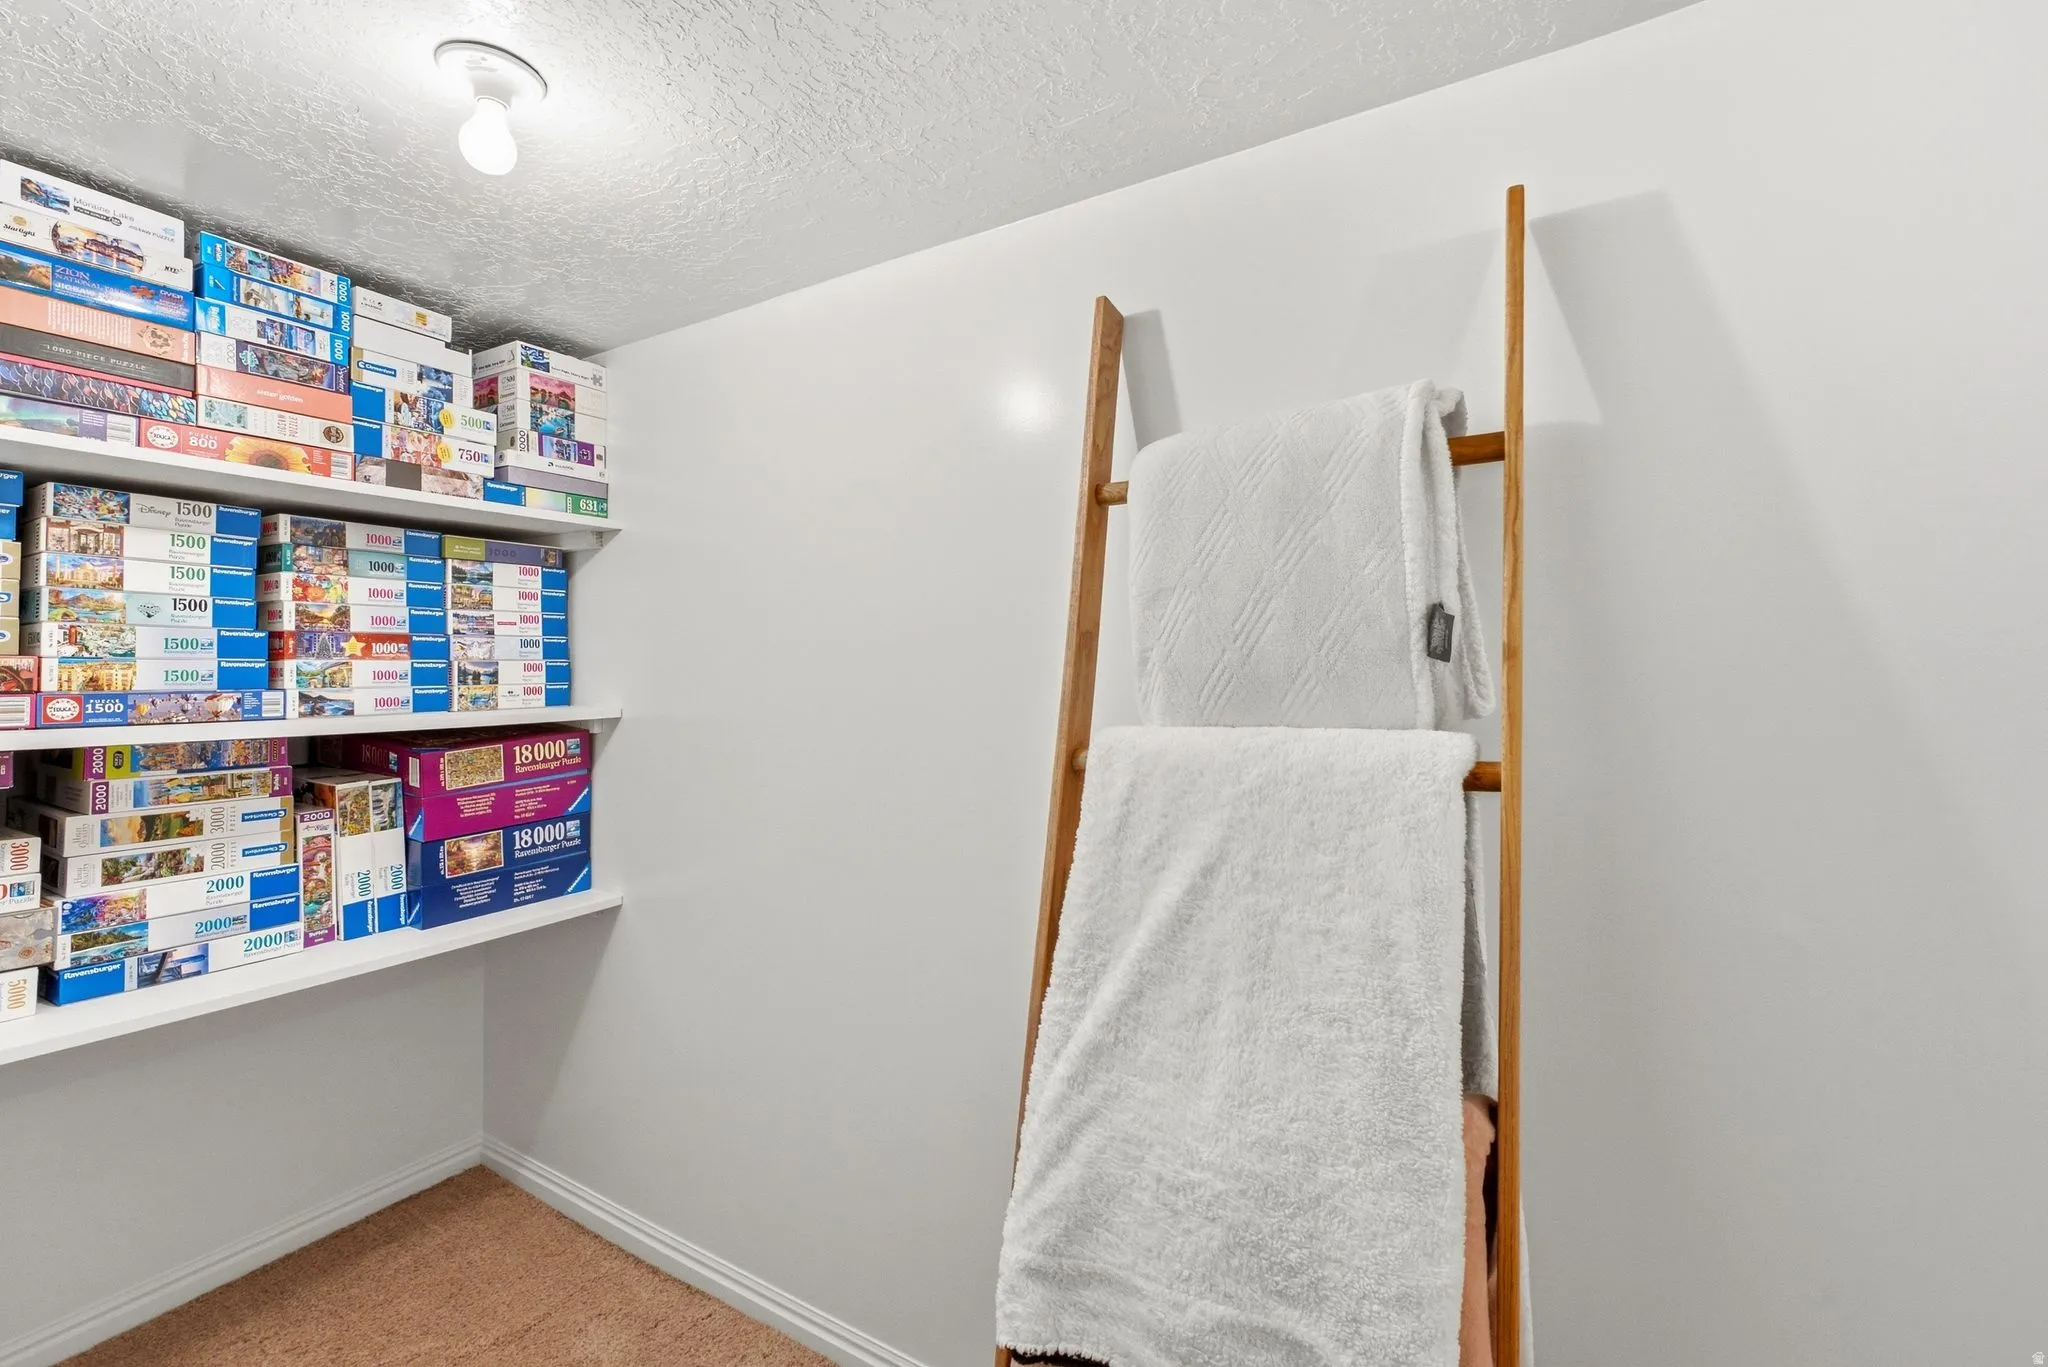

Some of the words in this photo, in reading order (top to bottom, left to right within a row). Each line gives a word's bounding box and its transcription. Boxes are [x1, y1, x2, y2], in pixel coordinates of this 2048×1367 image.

[55, 264, 90, 281] ZION
[338, 280, 348, 302] 1000
[341, 311, 351, 332] 1000
[334, 338, 343, 361] 1000
[76, 349, 107, 363] PIECE
[109, 358, 147, 371] PUZZLE
[279, 391, 304, 404] golden
[461, 414, 482, 429] 500
[189, 436, 218, 450] 800
[458, 448, 481, 463] 750
[136, 502, 172, 518] Disney
[176, 501, 212, 518] 1500
[580, 498, 598, 511] 631
[170, 533, 206, 550] 1500
[366, 533, 392, 546] 1000
[170, 566, 206, 581] 1500
[369, 561, 395, 573] 1000
[518, 566, 539, 577] 1000
[368, 588, 394, 599] 1000
[518, 590, 539, 601] 1000
[172, 598, 208, 613] 1500
[370, 615, 396, 627] 1000
[519, 614, 540, 625] 1000
[164, 637, 199, 650] 1500
[371, 642, 398, 654] 1000
[520, 638, 540, 648] 1000
[523, 663, 543, 672] 1000
[164, 669, 199, 682] 1500
[372, 670, 398, 681] 1000
[523, 686, 543, 696] 1000
[85, 703, 124, 714] 1500
[374, 697, 400, 708] 1000
[513, 740, 565, 764] 18000
[92, 747, 104, 774] 2000
[515, 760, 561, 774] Ravensburger
[562, 756, 582, 766] Puzzle
[95, 784, 107, 811] 2000
[210, 806, 225, 834] 3000
[303, 811, 331, 822] 2000
[513, 822, 565, 849] 18000
[10, 841, 30, 871] 3000
[514, 842, 560, 859] Ravensburger
[561, 838, 581, 849] Puzzle
[211, 842, 226, 871] 2000
[253, 866, 297, 879] Ravensburger
[390, 863, 404, 890] 2000
[206, 875, 244, 894] 2000
[358, 869, 371, 897] 2000
[252, 897, 296, 909] Ravensburger
[195, 916, 232, 935] 2000
[243, 932, 282, 952] 2000
[63, 962, 122, 980] Ravensburger
[8, 978, 27, 1009] 5000
